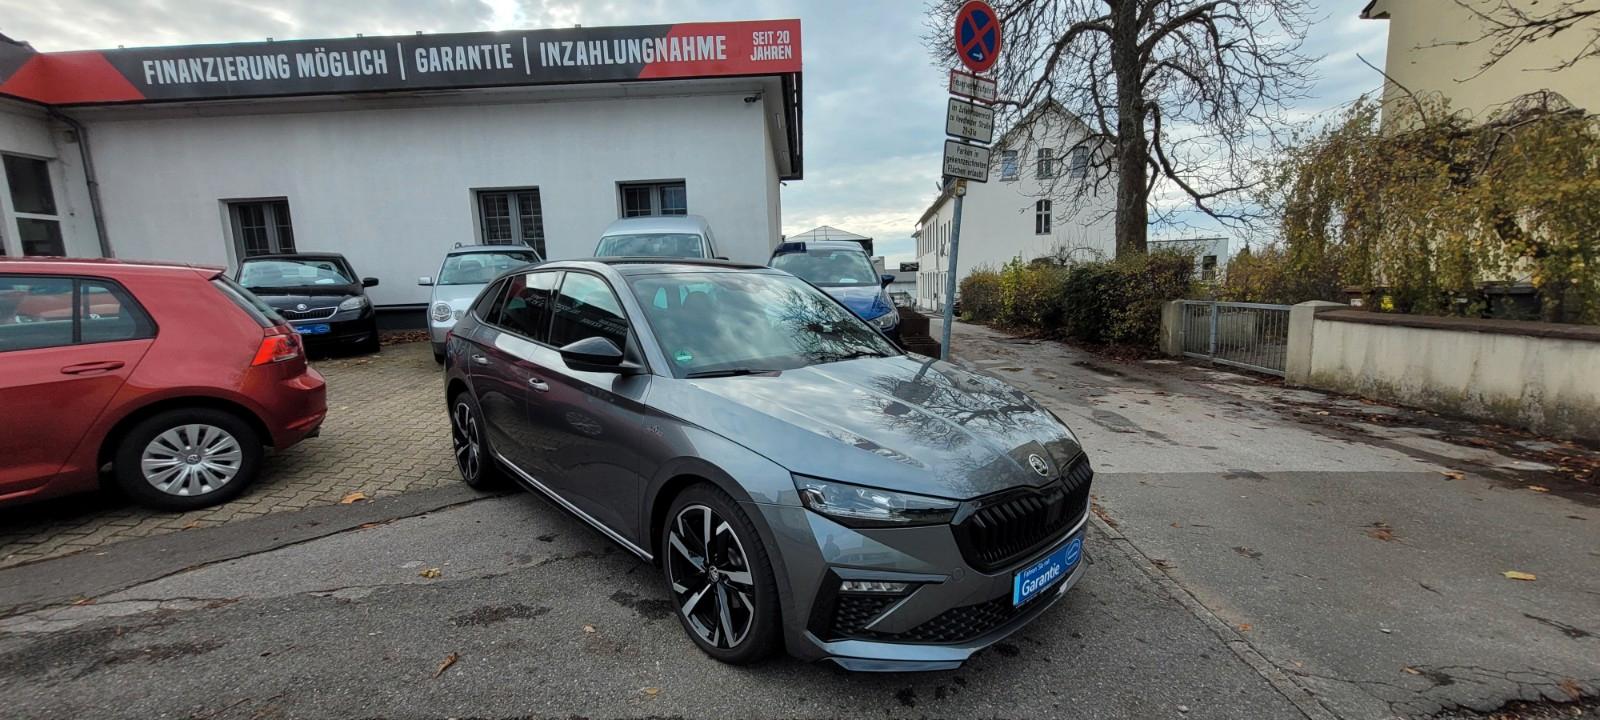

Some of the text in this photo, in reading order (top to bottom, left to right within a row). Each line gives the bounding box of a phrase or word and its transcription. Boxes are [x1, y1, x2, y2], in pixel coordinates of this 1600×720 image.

[752, 30, 790, 46] SEIT 20
[143, 35, 727, 85] FINANZIERUNG MÖGLICH GARANTIE INZAHLUNGNAHME
[750, 44, 792, 61] JAHREN
[957, 145, 973, 157] Parken
[1022, 562, 1060, 596] Garantie
